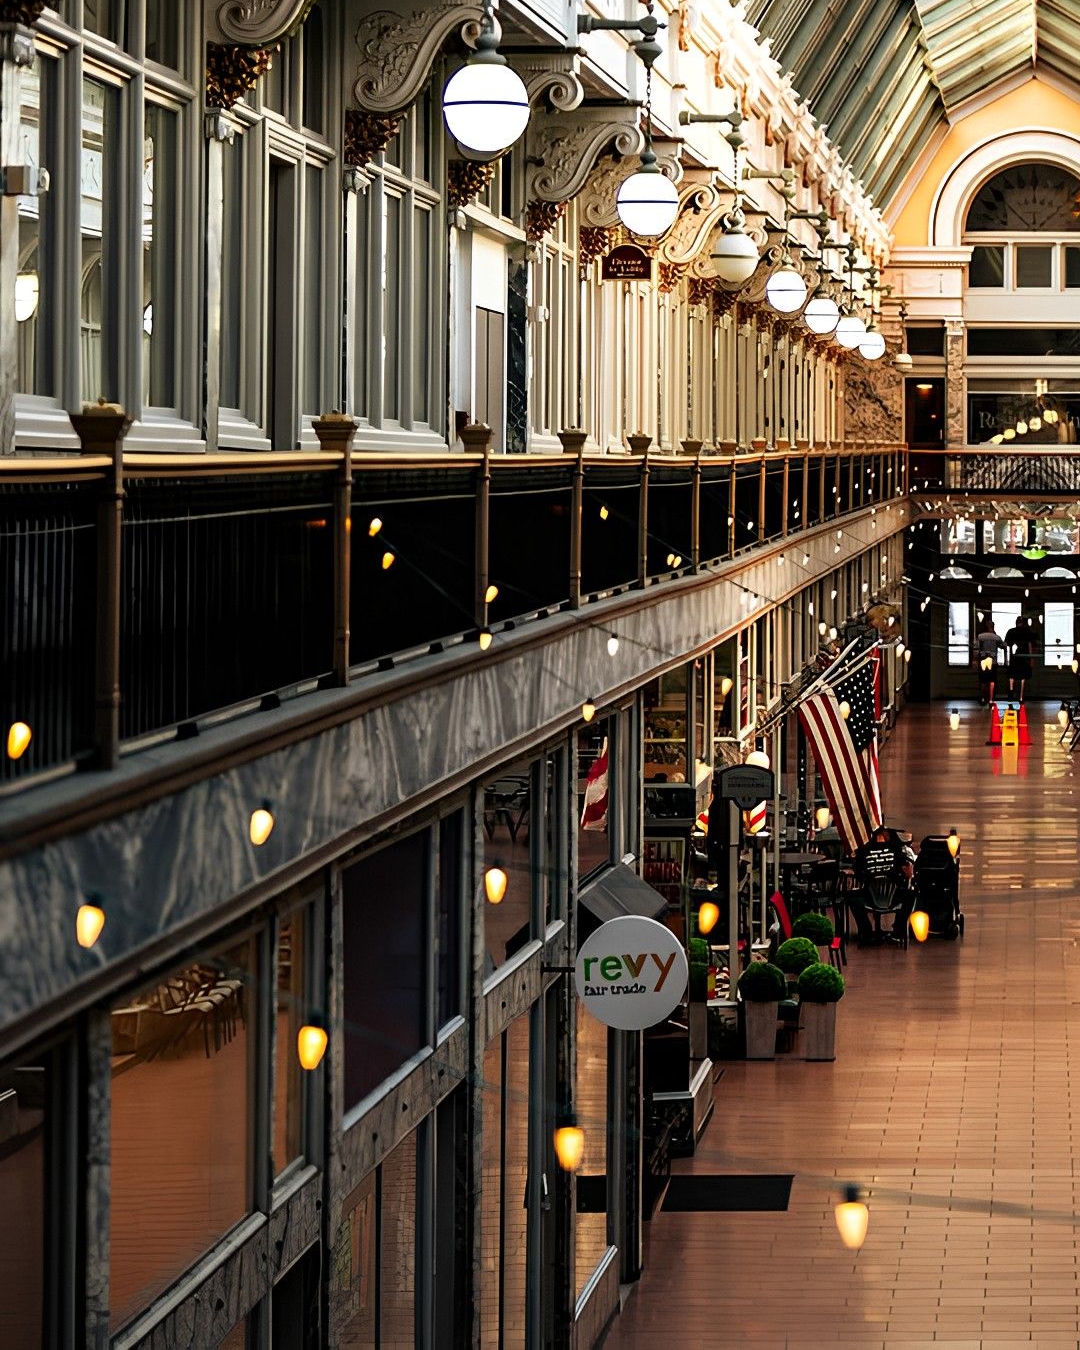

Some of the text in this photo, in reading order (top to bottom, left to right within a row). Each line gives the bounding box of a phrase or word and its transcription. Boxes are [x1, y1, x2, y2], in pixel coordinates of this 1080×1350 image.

[584, 952, 676, 992] revy
[584, 983, 647, 996] fair trade
